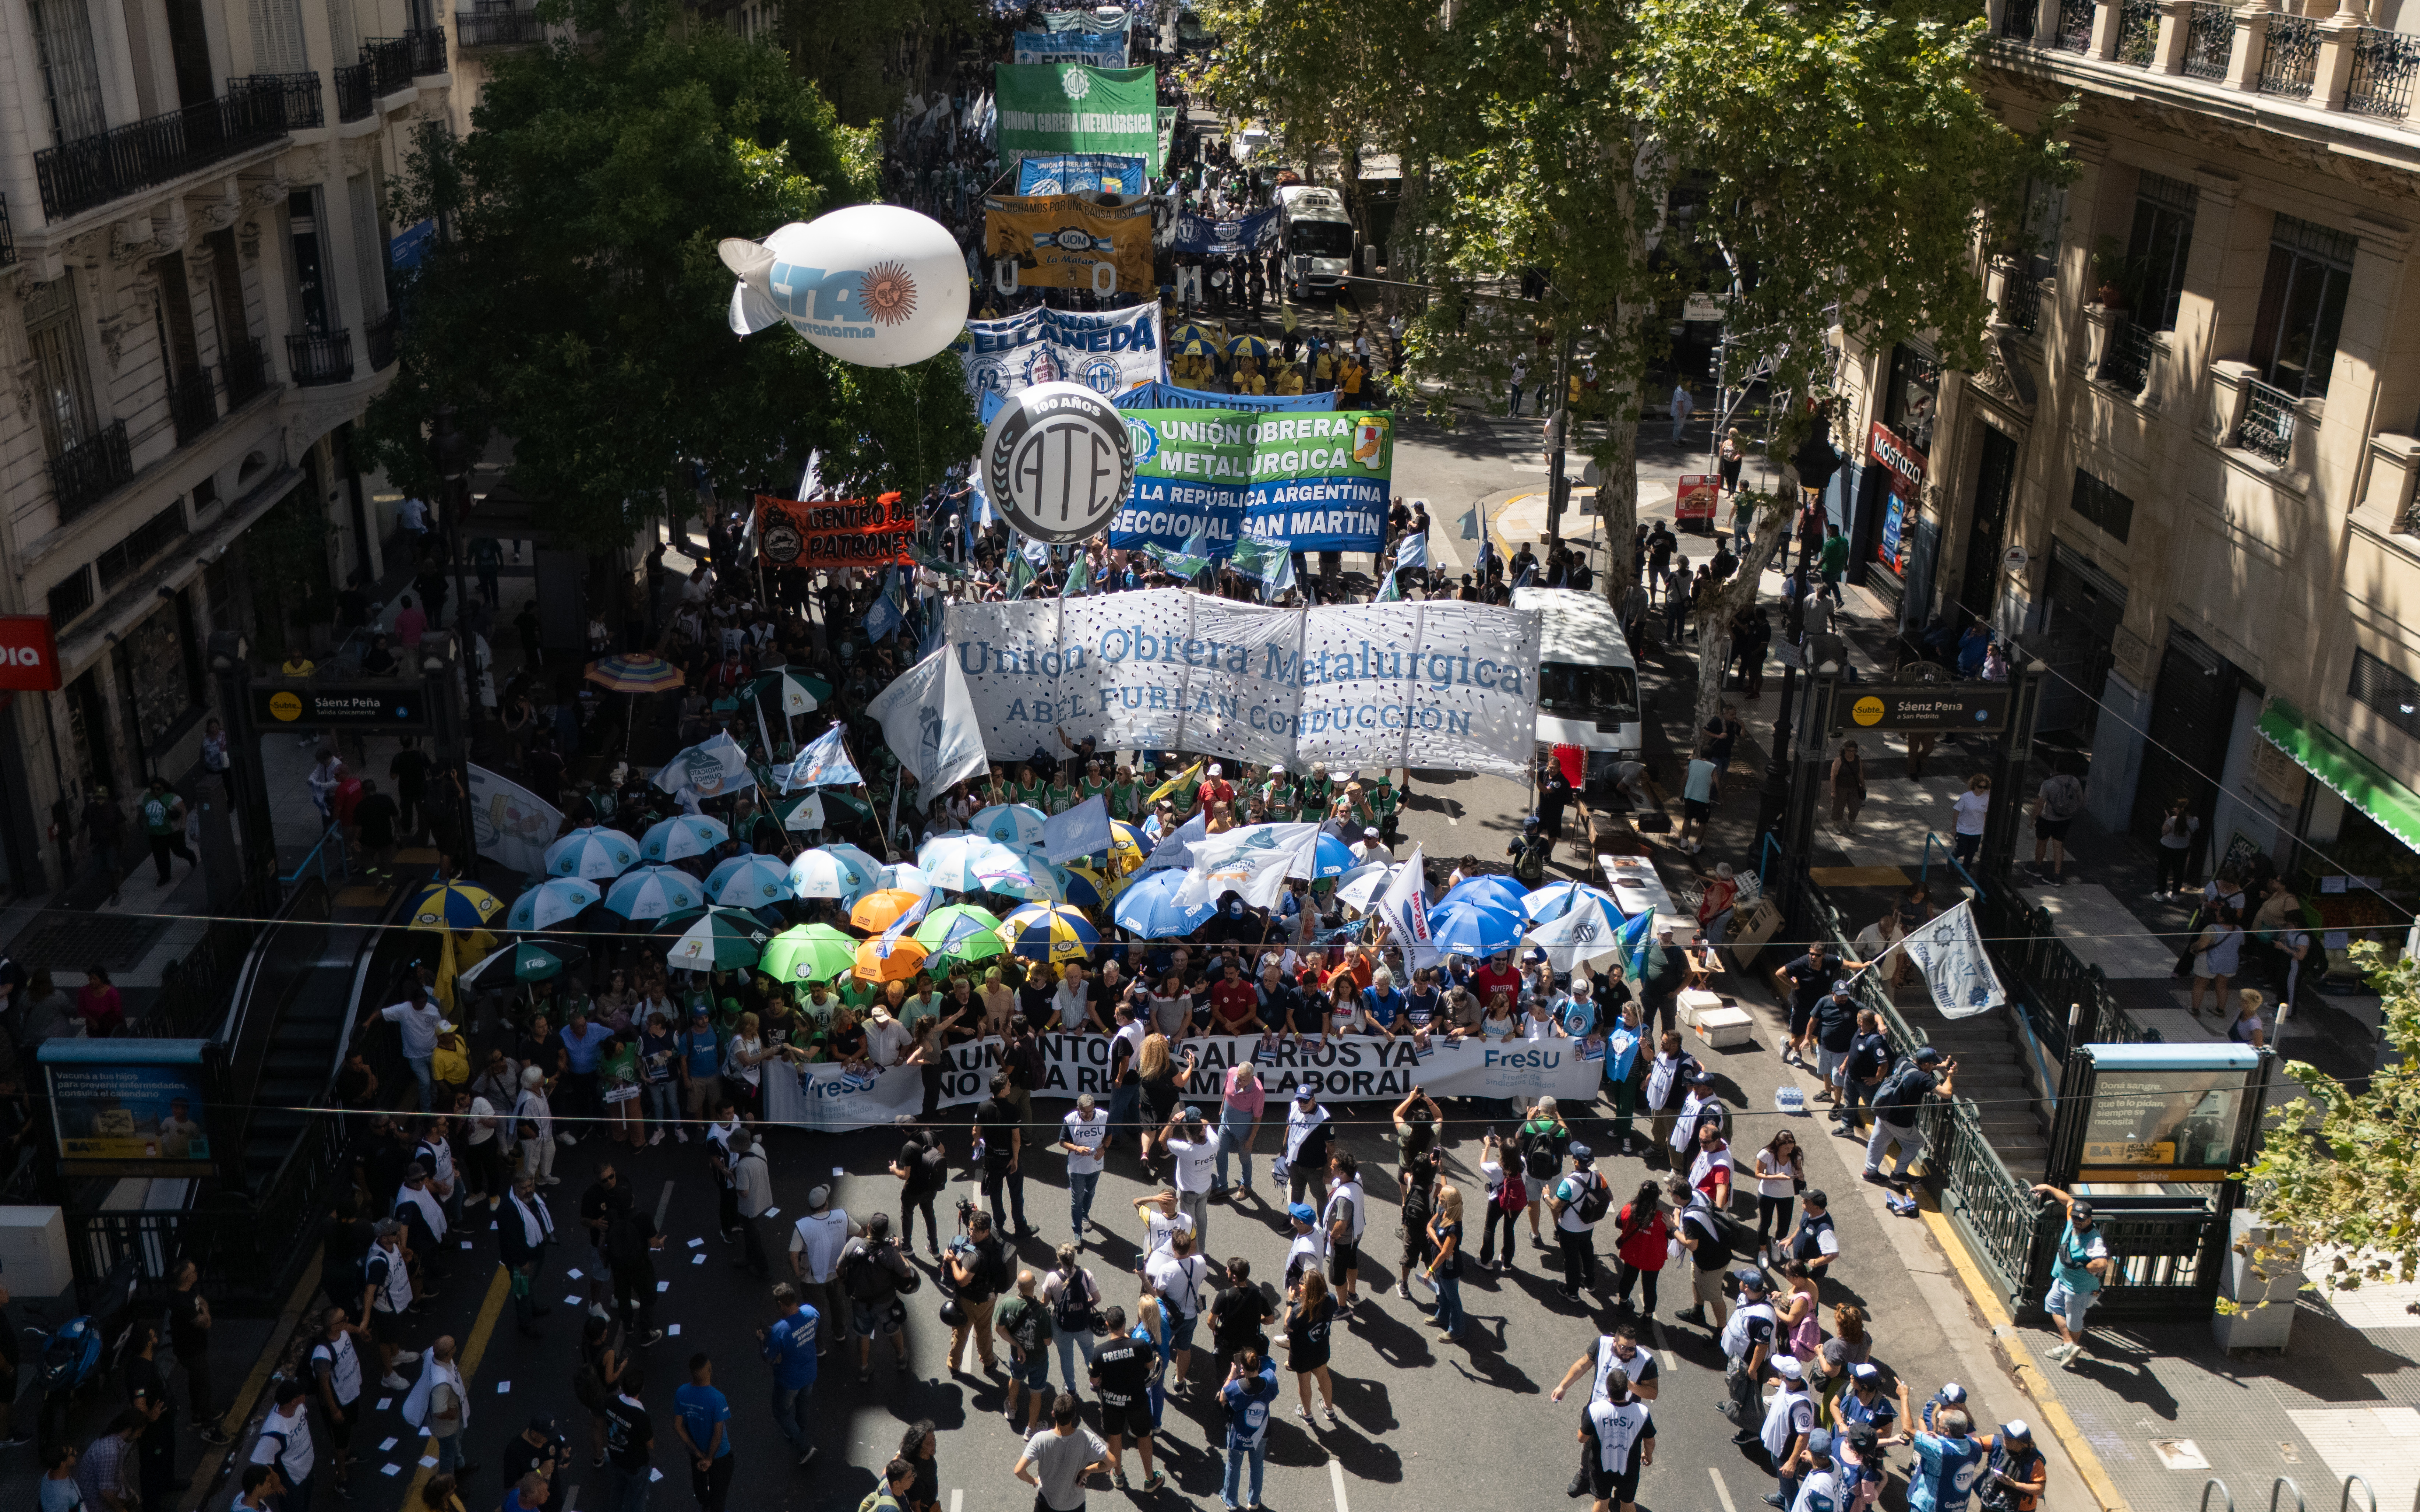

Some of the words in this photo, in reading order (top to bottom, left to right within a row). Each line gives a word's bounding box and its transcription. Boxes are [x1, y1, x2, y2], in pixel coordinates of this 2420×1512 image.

[1038, 113, 1079, 132] OBRERA
[1080, 111, 1152, 133] METALÚRGICA
[1002, 201, 1047, 213] LUCHAMOS
[1050, 200, 1066, 211] POR
[1068, 199, 1082, 212] UNA
[1084, 205, 1111, 220] CAUSA
[1063, 234, 1086, 245] UOM
[1181, 225, 1194, 238] 17
[1046, 254, 1059, 264] La
[1061, 255, 1098, 265] Matanz
[995, 260, 1019, 295] U
[1092, 262, 1116, 297] O
[1178, 265, 1202, 303] M
[958, 317, 1156, 354] ELLANEDA
[978, 369, 999, 389] 62
[1033, 399, 1058, 415] 100
[1061, 397, 1100, 416] AÑOS
[1160, 417, 1241, 445] UNIÓN
[1247, 418, 1350, 445] OBRERA
[1160, 448, 1348, 477] METALÚRGICA
[1015, 423, 1111, 522] ATE
[1128, 483, 1135, 499] E
[1141, 485, 1164, 501] LA
[1171, 487, 1265, 508] REPÚBLICA
[1273, 483, 1381, 503] ARGENTINA
[811, 504, 885, 529] CENTRO
[1108, 509, 1233, 541] SECCIONAL
[1241, 512, 1285, 537] SAN
[1291, 506, 1379, 536] MARTÍN
[959, 640, 1087, 678] Unión
[1100, 625, 1248, 674] Obrera
[1262, 640, 1523, 695] Metalúrgica
[315, 698, 349, 708] Sáenz
[353, 698, 380, 708] Peña
[1007, 694, 1086, 724] ABEL
[1098, 686, 1239, 719] FURLÁN
[1250, 699, 1472, 738] CONDUCCIÓN
[1898, 702, 1931, 711] Sáenz
[1054, 802, 1067, 815] ATE
[1412, 891, 1427, 940] MP25M
[1390, 915, 1412, 950] PRODUCTIVO
[798, 965, 809, 975] ATE
[1964, 963, 1977, 976] 17
[1491, 984, 1513, 992] SUTEPA
[943, 1035, 1108, 1073] AUMNTO
[1371, 1041, 1420, 1067] YA
[1485, 1050, 1560, 1069] FreSU
[80, 1081, 117, 1090] prevenir
[116, 1072, 138, 1081] hijos
[939, 1073, 981, 1098] NO
[1265, 1070, 1415, 1095] LABORAL
[1485, 1078, 1526, 1088] Sindicatos
[1528, 1078, 1556, 1089] Unidos
[1502, 1073, 1526, 1081] Frente
[2101, 1081, 2125, 1090] Doná
[2127, 1082, 2162, 1091] sangre.
[2096, 1109, 2133, 1118] siempre
[2137, 1100, 2165, 1109] pidan,
[2137, 1172, 2169, 1181] Subte
[1102, 1347, 1134, 1362] PRENSA
